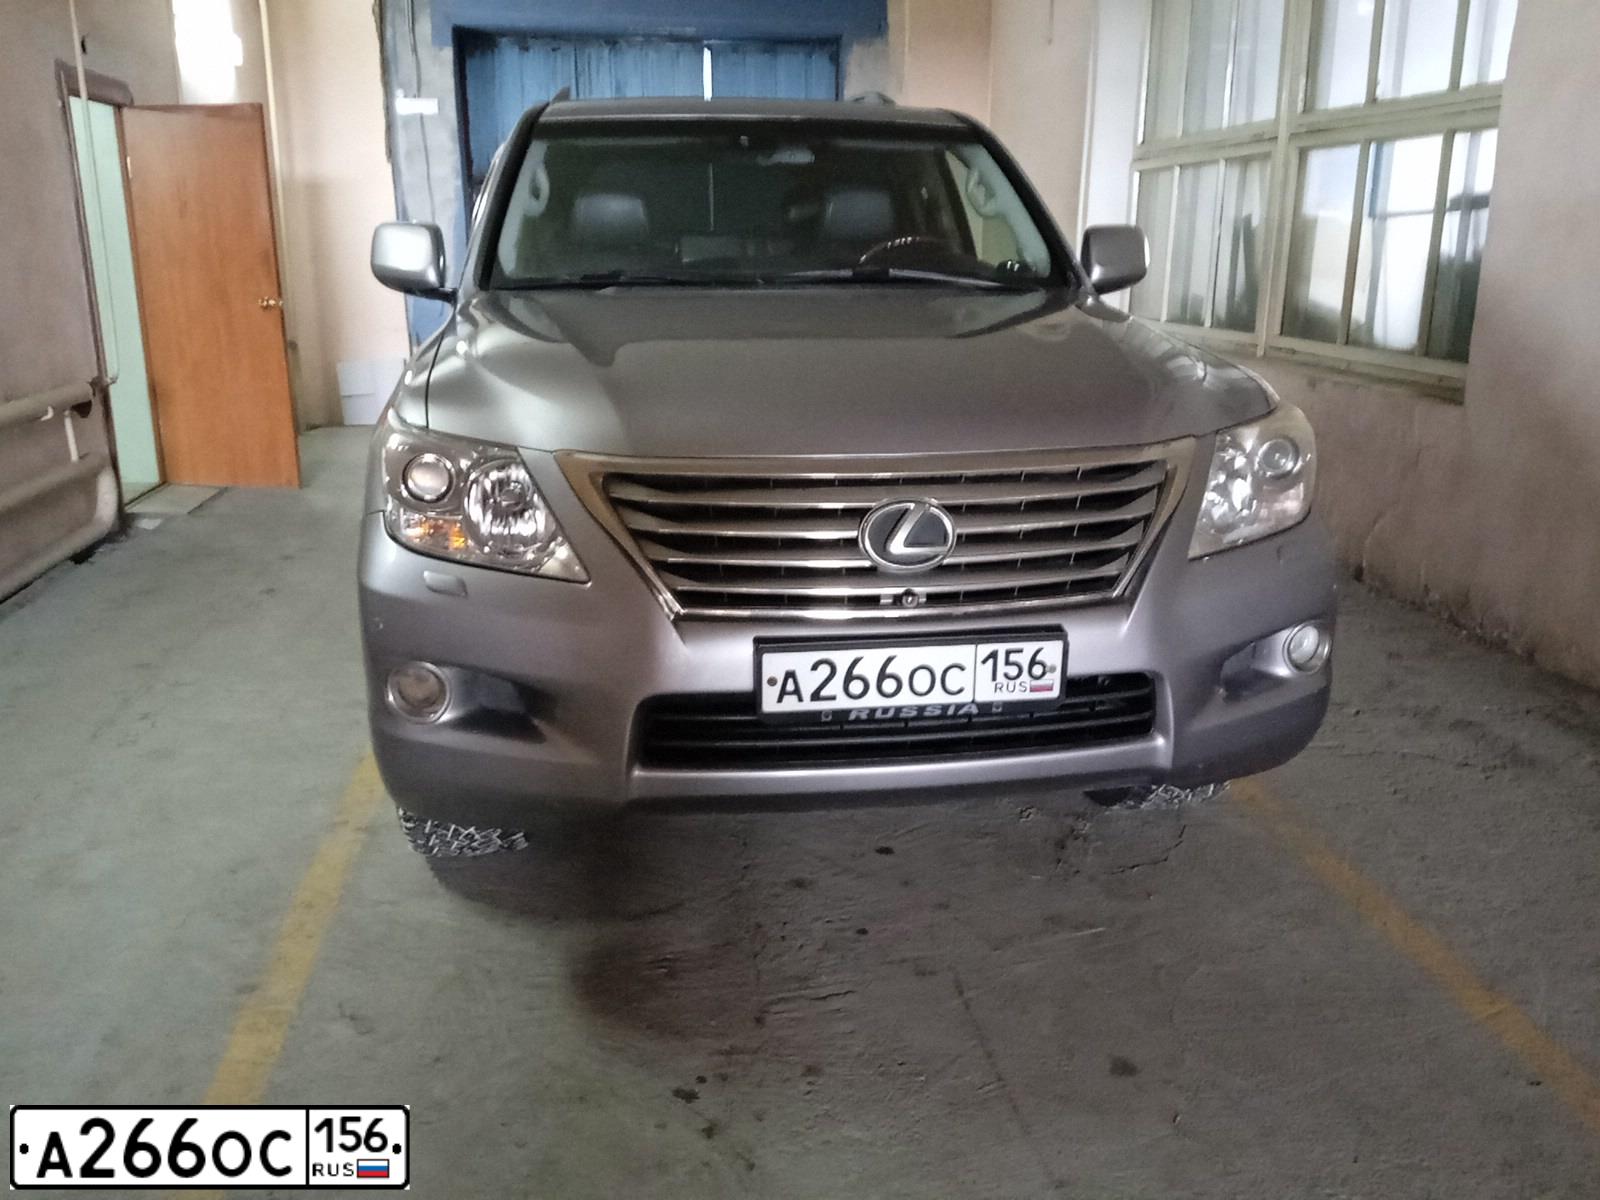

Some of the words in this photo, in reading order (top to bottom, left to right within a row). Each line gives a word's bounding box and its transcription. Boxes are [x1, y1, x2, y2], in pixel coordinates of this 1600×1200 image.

[776, 655, 967, 703] A266OC
[981, 647, 1047, 682] 156
[994, 681, 1028, 693] RUS
[848, 703, 979, 721] RUSSIA
